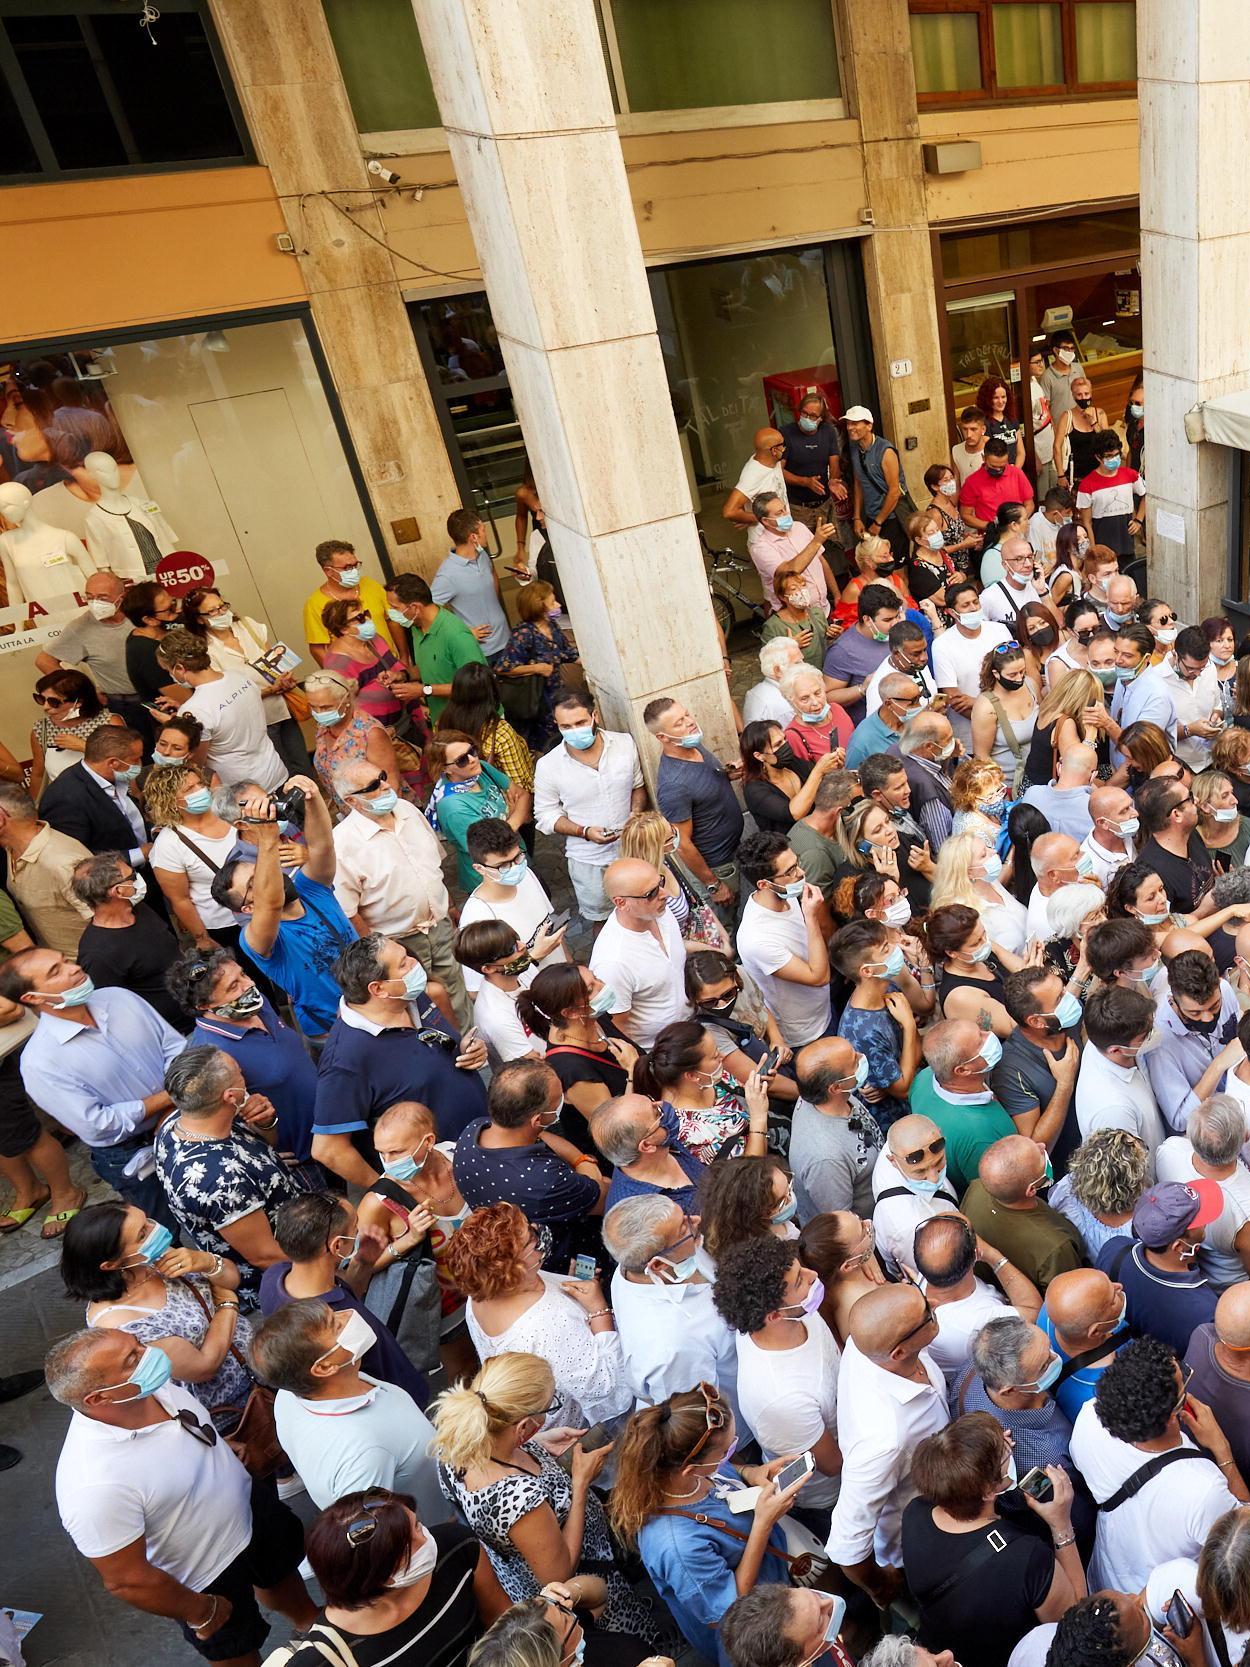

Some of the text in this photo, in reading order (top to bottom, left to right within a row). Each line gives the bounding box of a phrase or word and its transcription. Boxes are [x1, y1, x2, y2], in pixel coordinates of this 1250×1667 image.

[895, 363, 908, 375] 21
[684, 405, 719, 434] TAL
[159, 570, 175, 580] UP
[161, 578, 177, 587] TO
[47, 630, 62, 638] CO
[219, 680, 252, 710] ALPINE
